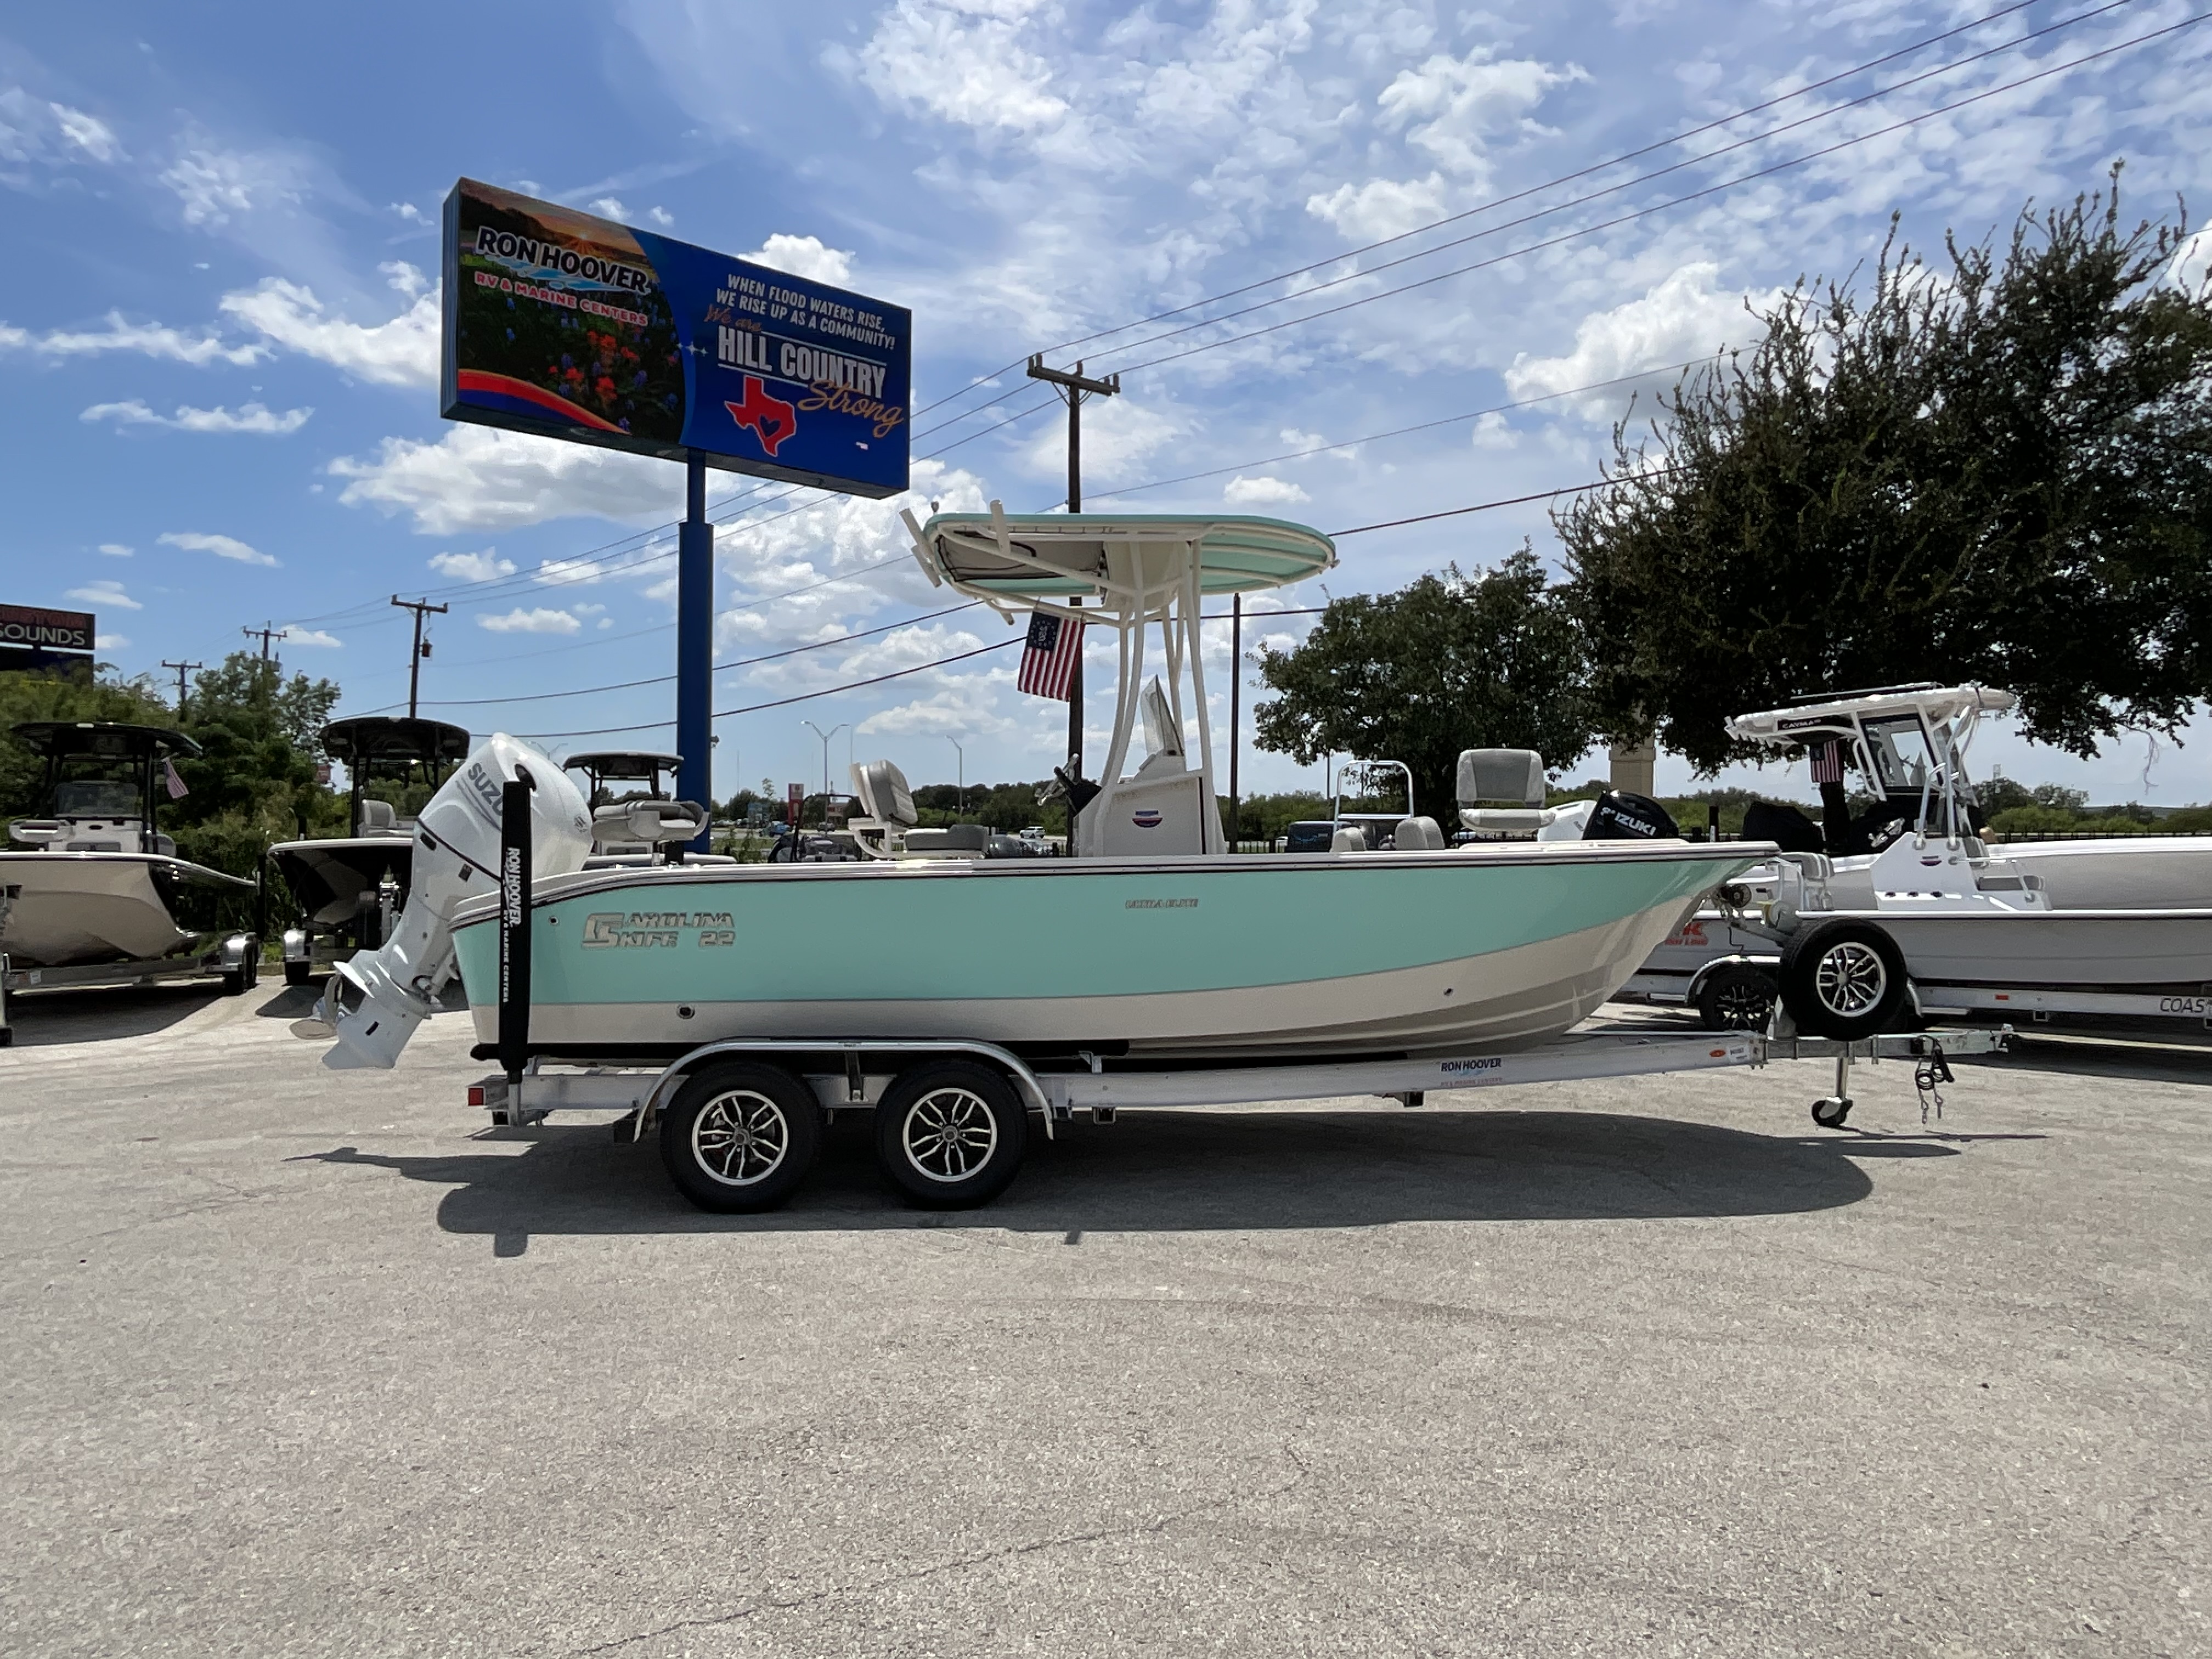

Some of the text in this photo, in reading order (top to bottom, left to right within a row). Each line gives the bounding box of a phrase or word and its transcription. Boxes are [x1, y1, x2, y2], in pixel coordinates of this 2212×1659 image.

[476, 225, 650, 295] RON HOOVER
[475, 272, 648, 326] RV & MARINE CENTERS
[703, 303, 763, 332] We are
[716, 288, 895, 350] WE RISE UP AS A COMMUNITY!
[727, 273, 885, 332] WHEN FLOOD WATERS RISE,
[718, 325, 886, 398] HILL COUNTRY
[797, 379, 904, 438] Strong
[467, 763, 503, 816] SUZU
[1602, 808, 1657, 837] ZUKI
[507, 847, 521, 927] RON HOOVER
[584, 912, 735, 936] CAROLINA
[698, 930, 735, 948] 22
[1441, 1058, 1502, 1072] RON HOOVER
